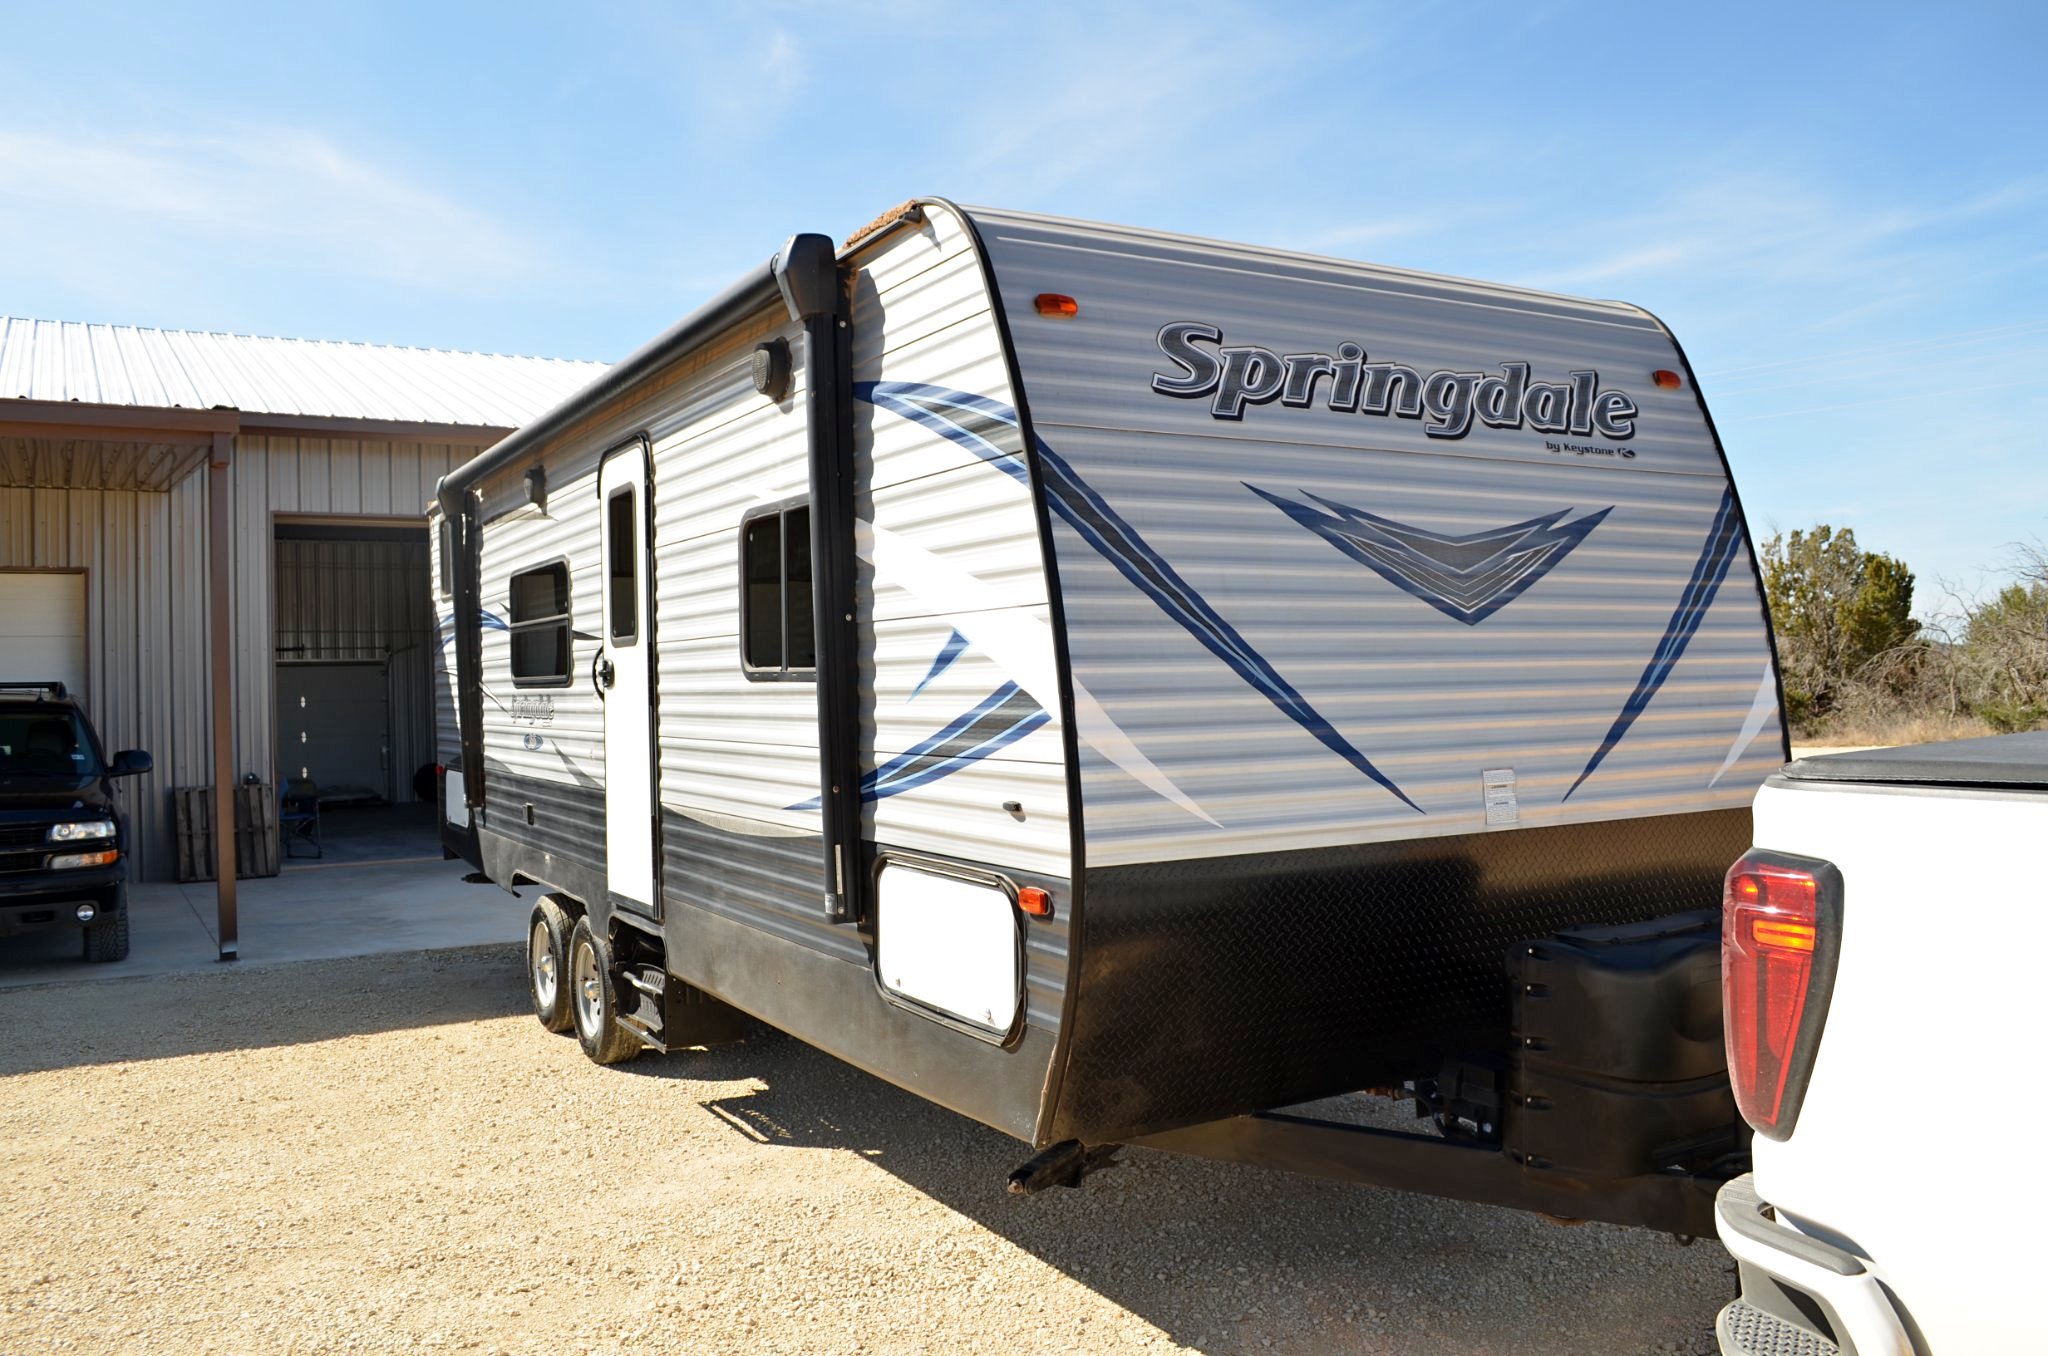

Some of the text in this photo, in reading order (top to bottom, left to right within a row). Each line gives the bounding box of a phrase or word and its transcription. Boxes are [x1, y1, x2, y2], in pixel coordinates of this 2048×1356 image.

[1151, 321, 1638, 440] Springdale
[1545, 441, 1614, 455] by Keystone
